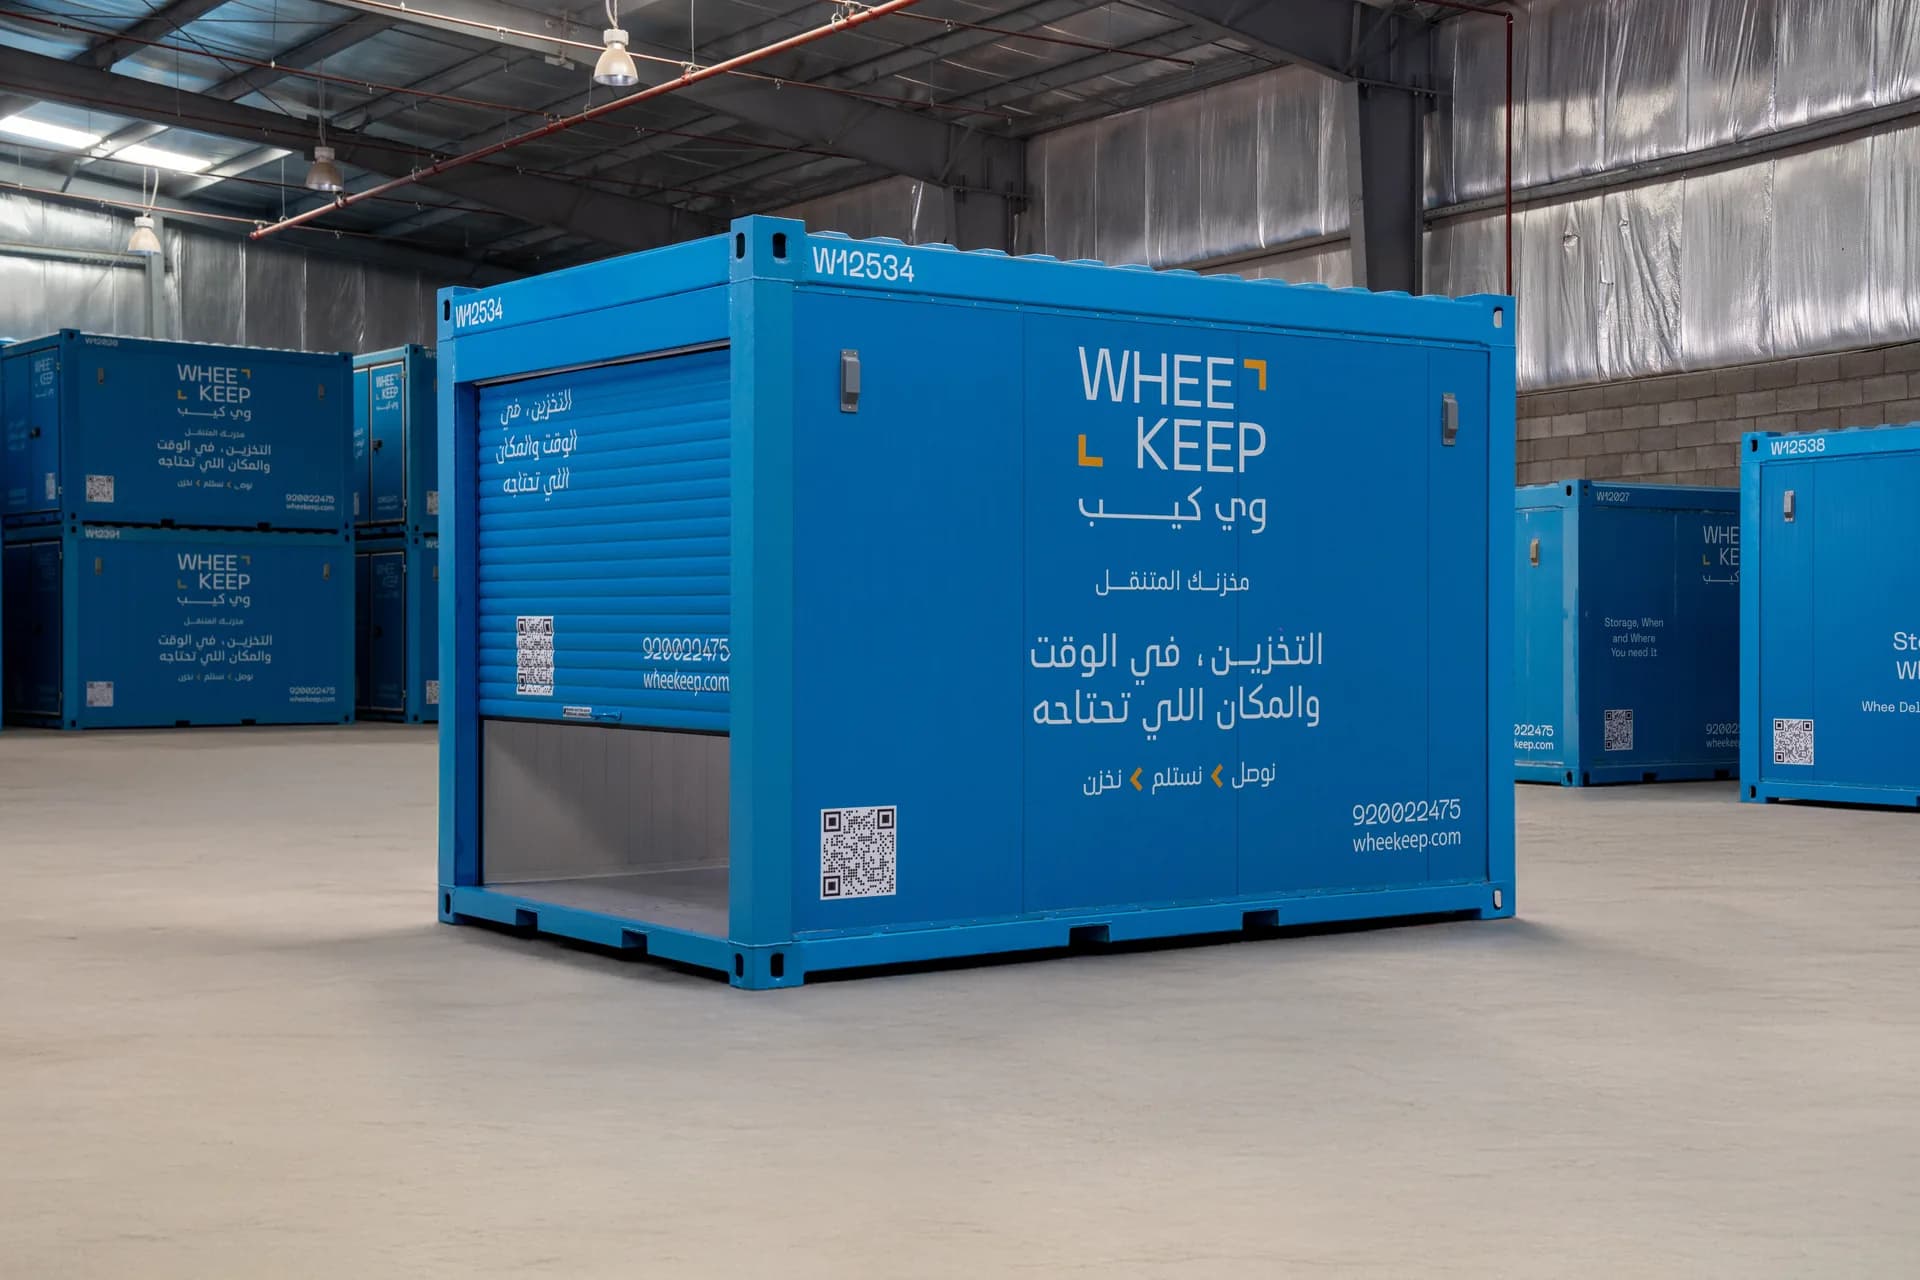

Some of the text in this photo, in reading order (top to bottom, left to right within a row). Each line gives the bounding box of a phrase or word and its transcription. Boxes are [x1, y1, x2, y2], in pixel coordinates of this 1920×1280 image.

[812, 246, 915, 283] W12534
[455, 297, 503, 328] W12534
[177, 364, 238, 384] WHEE
[1078, 346, 1234, 410] WHEE
[199, 385, 251, 403] KEEP
[230, 408, 251, 422] وي
[500, 398, 521, 431] في
[157, 440, 191, 454] الوقت
[195, 442, 215, 457] في
[495, 428, 577, 464] الوقت والمكان
[1137, 416, 1267, 473] KEEP
[1770, 438, 1826, 456] W12538
[200, 458, 225, 473] اللي
[228, 459, 271, 474] والمكان
[503, 467, 570, 501] اللي تحتاجه
[1078, 486, 1267, 534] وي كيب
[177, 553, 238, 571] WHEE
[199, 573, 251, 590] KEEP
[1095, 568, 1249, 597] مخزنك المتنقل
[229, 594, 251, 608] وي
[1604, 617, 1664, 630] Storage, When
[158, 635, 192, 648] الوقت
[196, 635, 216, 650] في
[1612, 632, 1656, 643] and Where
[200, 651, 225, 667] اللي
[229, 651, 271, 665] والمكان
[642, 637, 731, 662] 920022475
[1030, 632, 1118, 678] الوقت
[1611, 647, 1626, 657] You
[1628, 647, 1648, 657] need
[1130, 636, 1180, 686] في
[643, 668, 730, 696] wheekeep.com
[1142, 687, 1204, 741] اللي
[1216, 684, 1321, 730] والمكان
[1862, 700, 1896, 713] Whee
[1083, 761, 1276, 796] نوصل نستلم نخزن
[1352, 798, 1461, 826] 920022475
[1353, 830, 1461, 853] wheekeep.com
